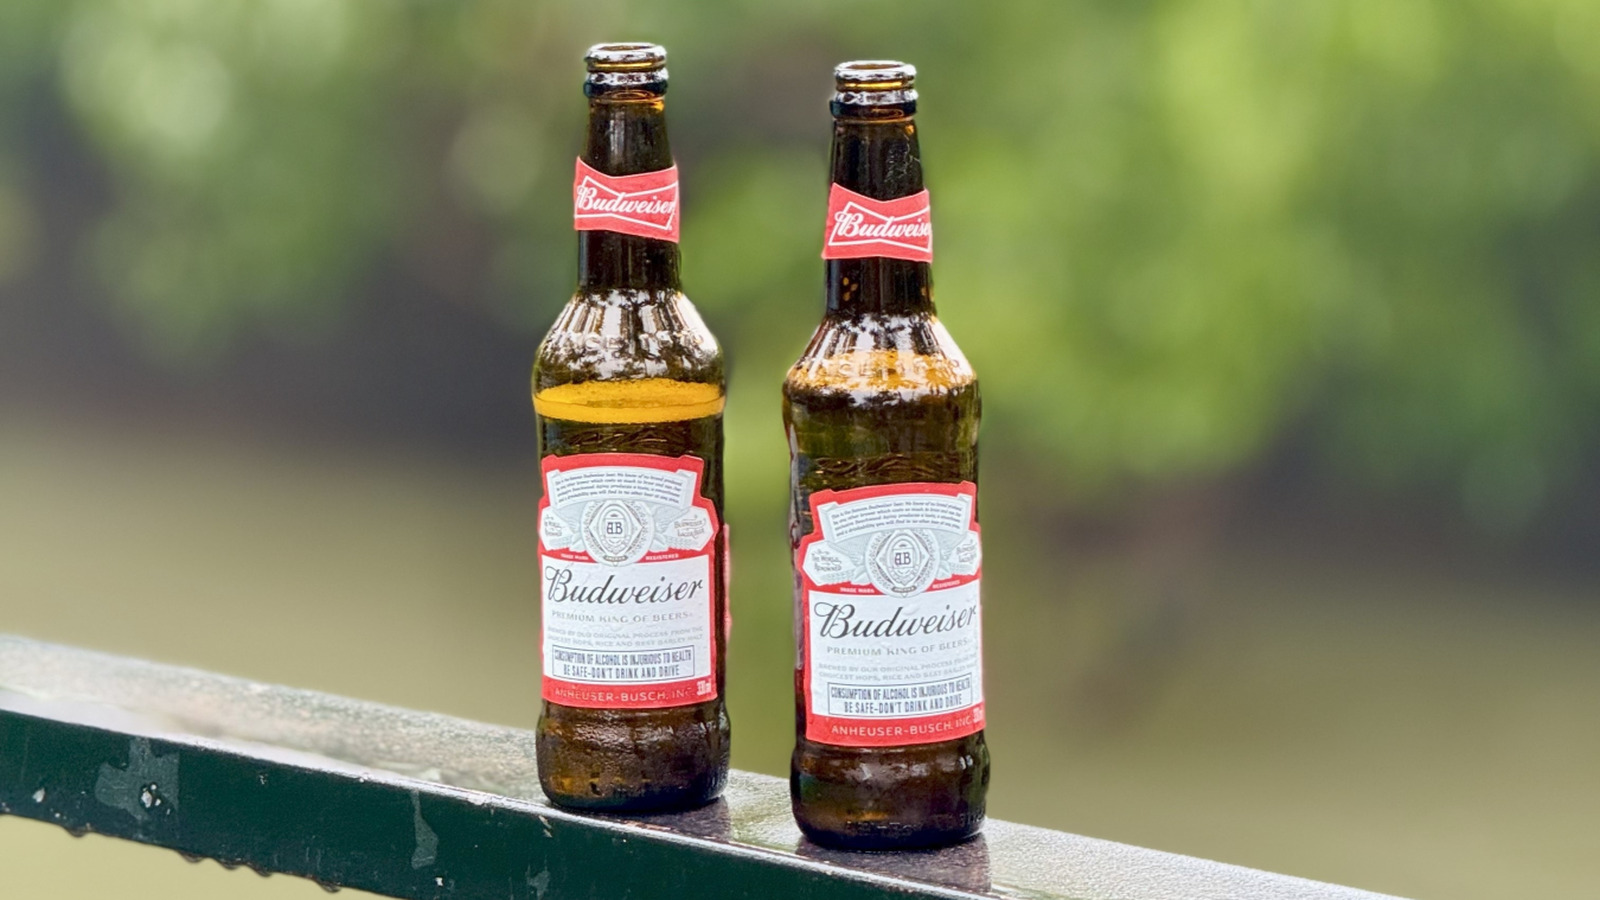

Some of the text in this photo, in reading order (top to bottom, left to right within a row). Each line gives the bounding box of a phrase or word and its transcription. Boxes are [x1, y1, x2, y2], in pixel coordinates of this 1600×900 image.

[577, 185, 676, 214] Budweiser
[834, 211, 931, 237] Budweise
[545, 566, 703, 604] Budweiser
[552, 611, 689, 624] PREMIUM KING OF BEERS
[814, 602, 976, 639] Budweiser
[587, 653, 594, 665] OF
[595, 653, 621, 666] ALCOHOL
[621, 654, 628, 666] IS
[629, 652, 662, 666] INJURIOUS
[663, 651, 671, 663] TO
[672, 649, 692, 662] HEALTH
[826, 638, 968, 657] PREMIUM KING OF BEERS
[563, 664, 680, 679] BE SAFE-DON'T DRINK AND DRIVE
[831, 686, 872, 700] CONSUMPTION
[873, 688, 881, 700] OF
[882, 687, 910, 700] ALCOHOL
[911, 687, 917, 699] IS
[919, 682, 948, 698] INJURIOUS
[844, 693, 962, 714] BE SAFE-DON'T DRINK AND DRIVE
